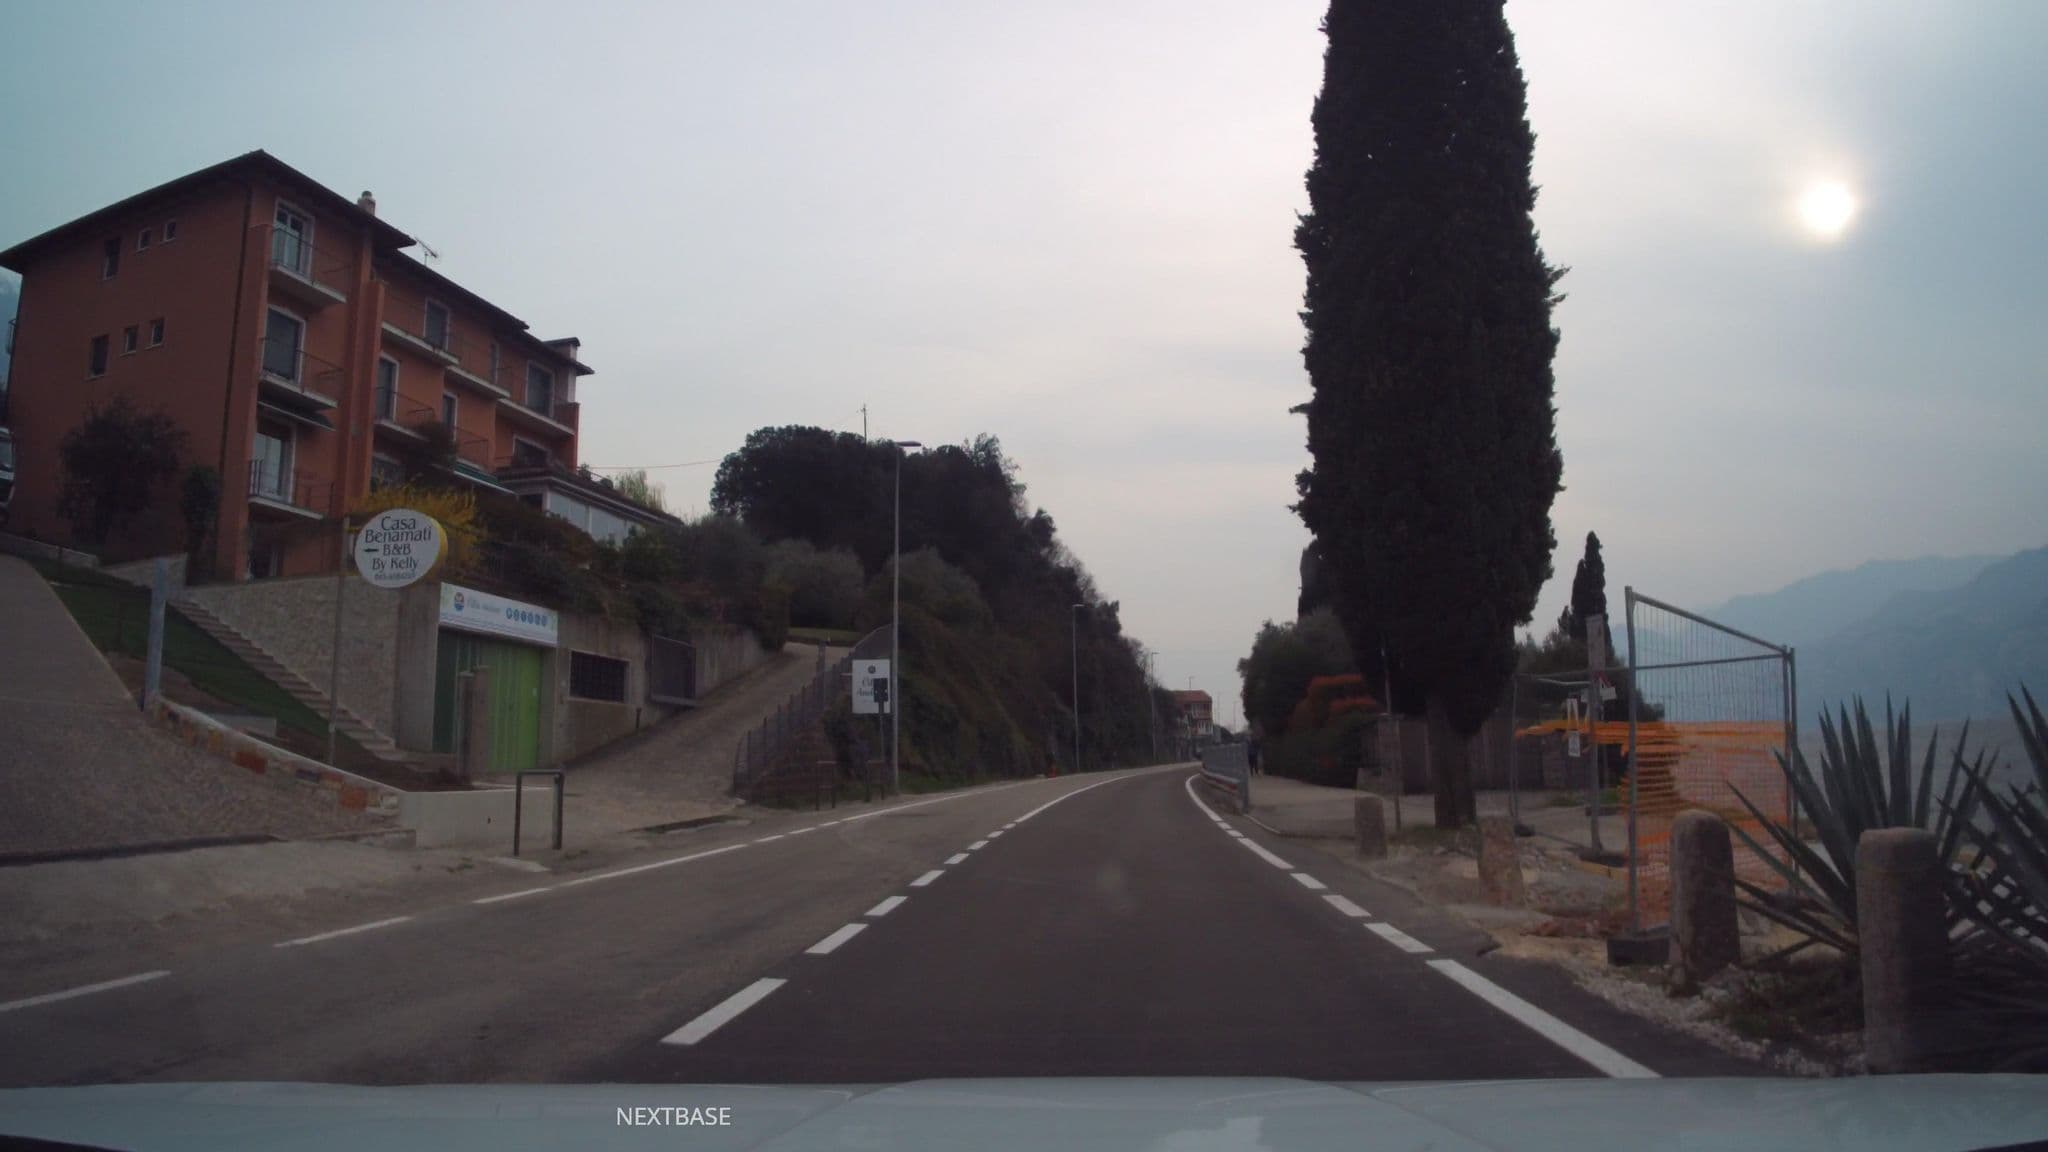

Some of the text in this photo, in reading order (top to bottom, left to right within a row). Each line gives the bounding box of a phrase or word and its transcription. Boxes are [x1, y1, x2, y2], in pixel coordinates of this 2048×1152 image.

[381, 516, 416, 531] Casa
[365, 526, 431, 543] Benamati
[383, 543, 411, 556] B&B
[372, 556, 419, 573] By Kelly
